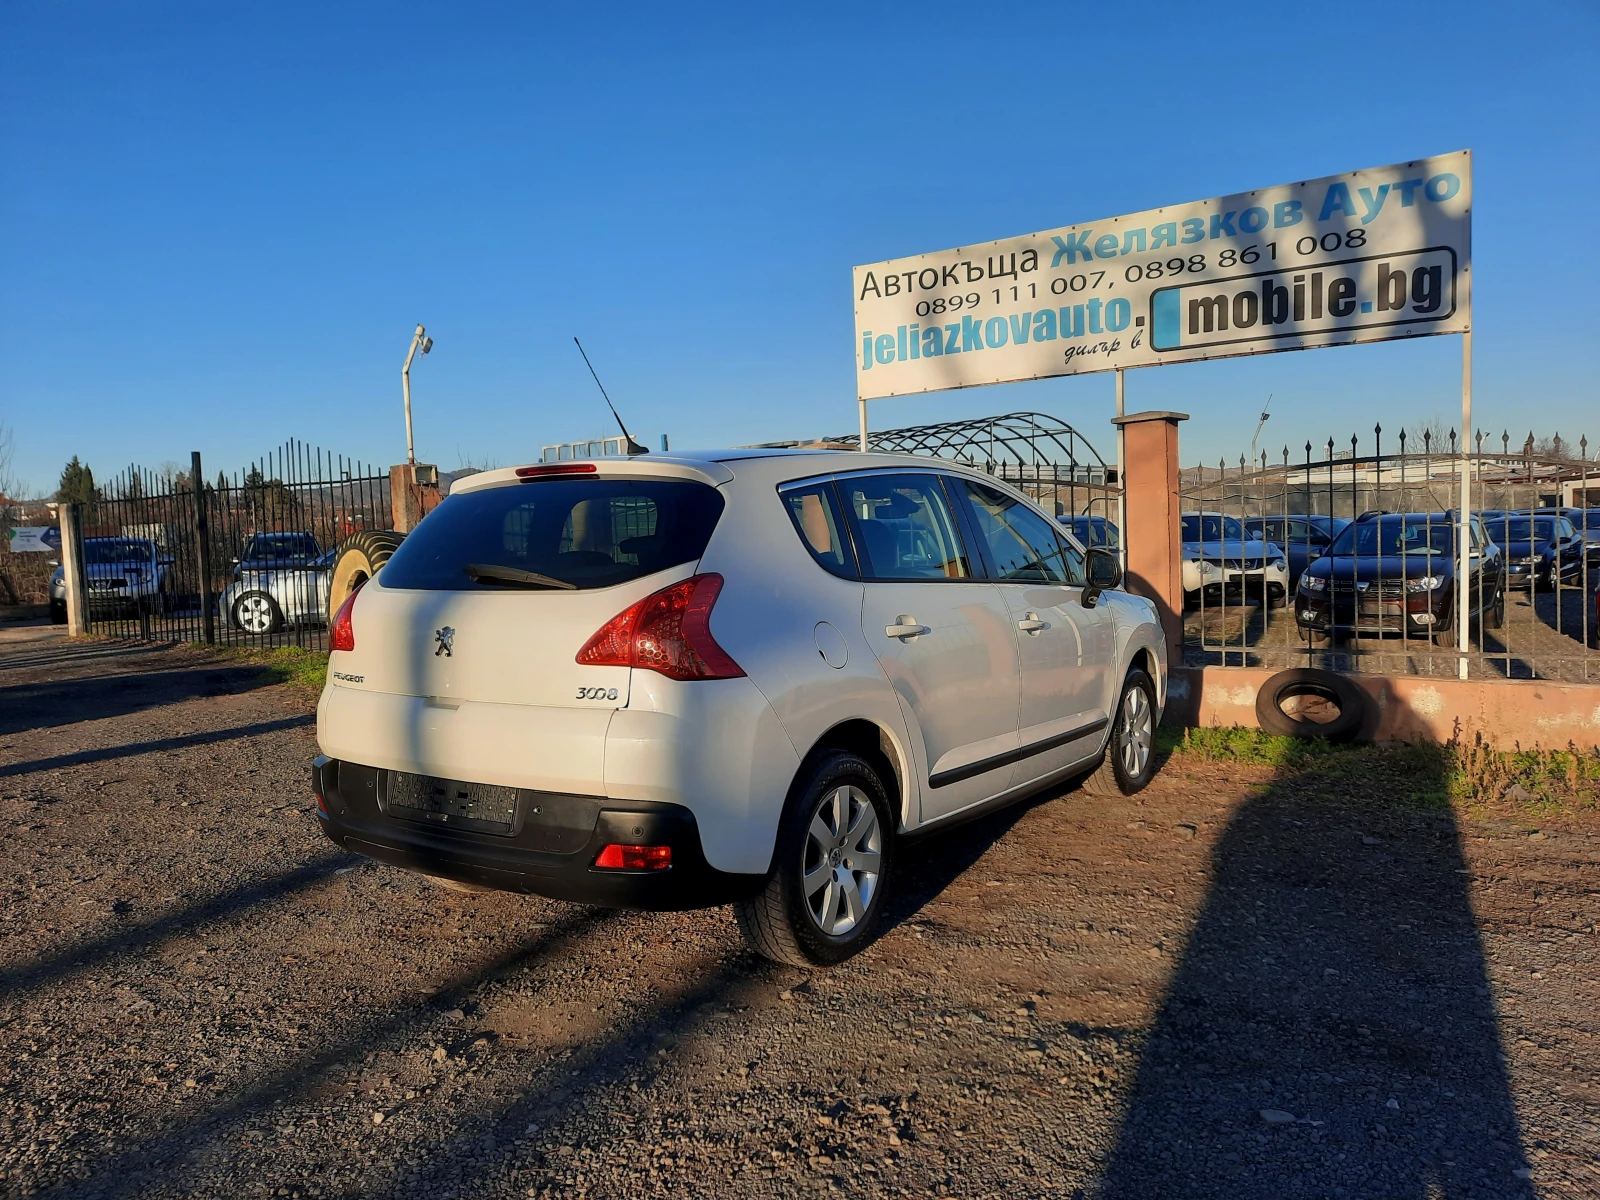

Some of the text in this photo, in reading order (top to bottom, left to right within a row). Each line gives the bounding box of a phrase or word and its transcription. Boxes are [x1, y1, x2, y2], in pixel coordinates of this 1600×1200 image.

[860, 172, 1461, 301] Автокъща Желязков Ауто
[915, 228, 1367, 317] 0899 111 007, 0898 861 008
[1188, 262, 1442, 335] mobile.bg
[1064, 329, 1144, 364] дилър в
[333, 671, 365, 683] PEUGEOT
[575, 687, 619, 700] 3008
